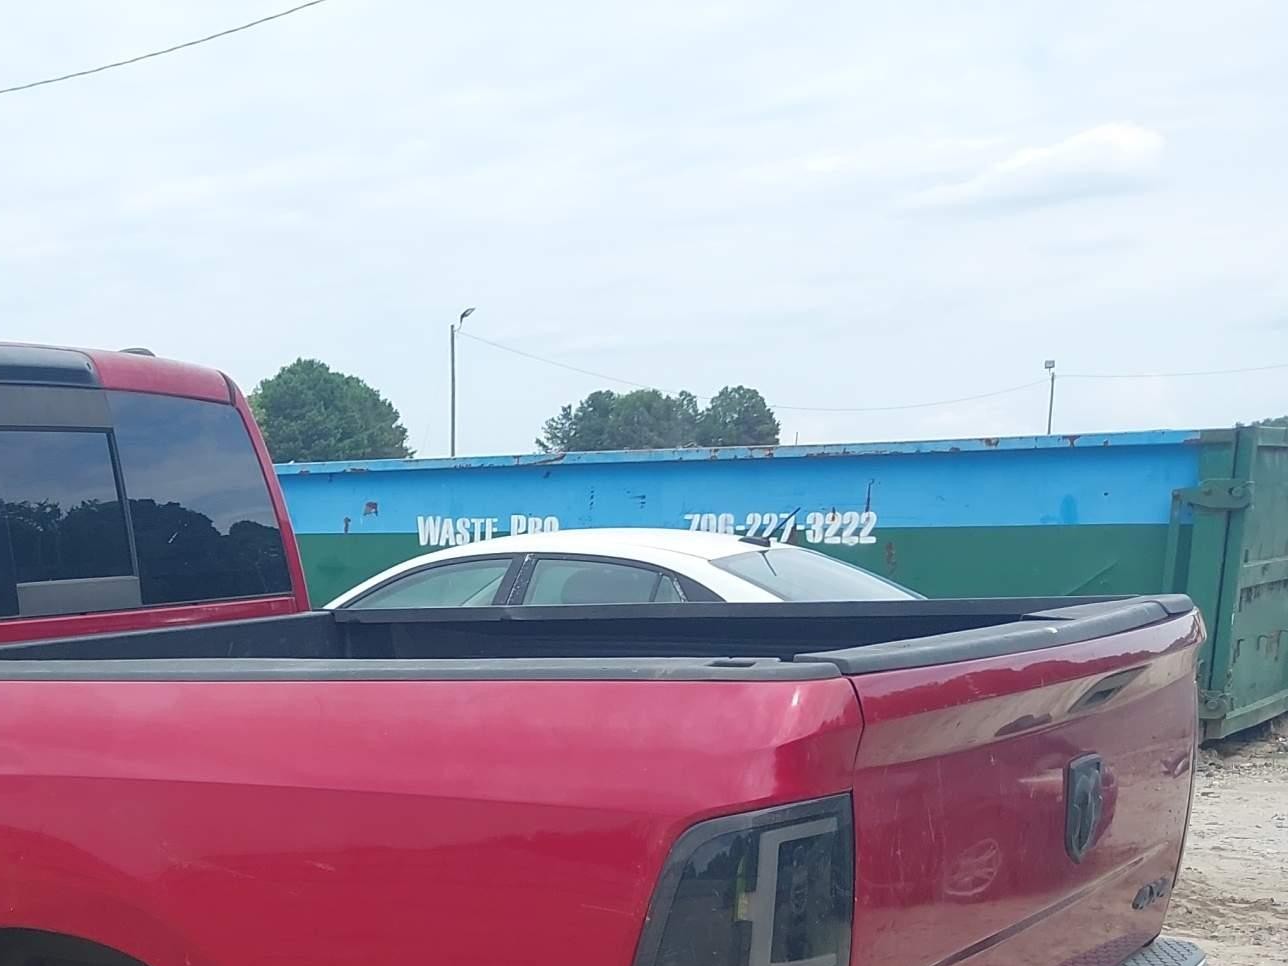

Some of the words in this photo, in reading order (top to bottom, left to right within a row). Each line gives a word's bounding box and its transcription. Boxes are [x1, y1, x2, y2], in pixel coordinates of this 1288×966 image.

[416, 515, 499, 546] WASTE
[511, 514, 560, 537] PRO
[684, 511, 877, 545] 706-227-3222
